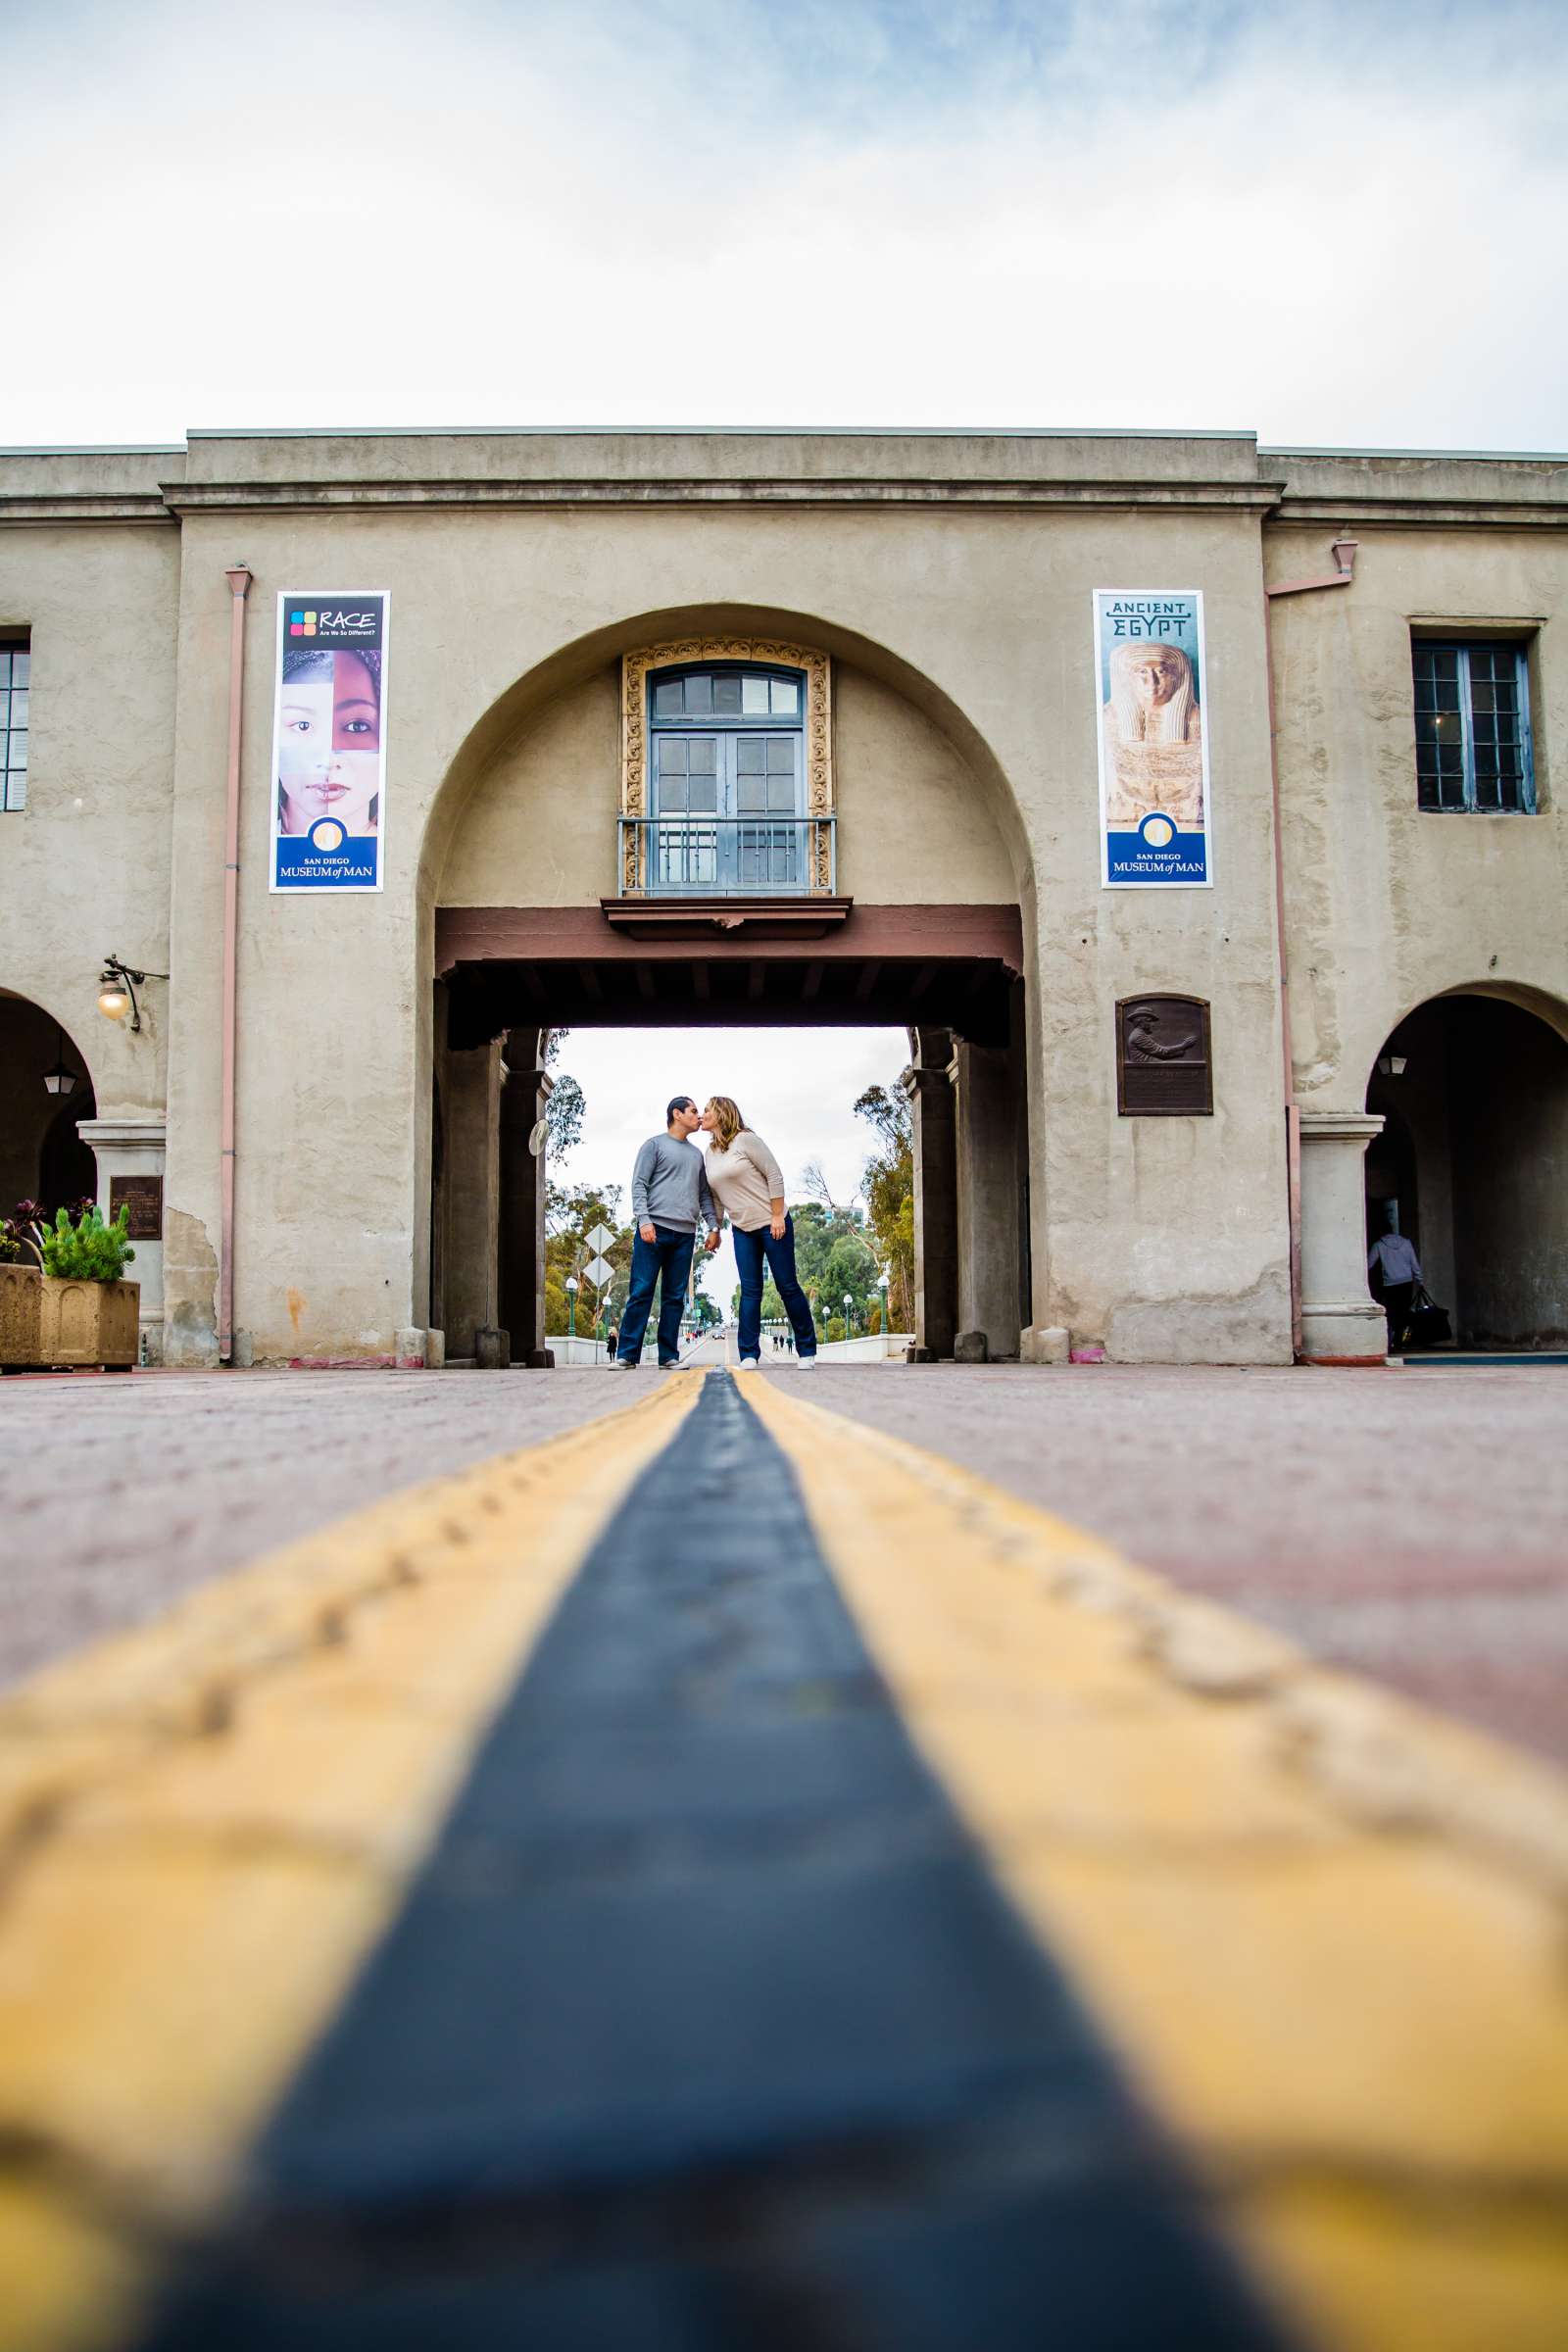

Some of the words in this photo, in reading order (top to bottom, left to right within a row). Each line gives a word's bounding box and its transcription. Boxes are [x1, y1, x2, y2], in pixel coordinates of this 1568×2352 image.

[1113, 603, 1186, 613] ANCIENT
[319, 612, 376, 628] RACE
[1113, 616, 1187, 636] EGYPT
[280, 866, 332, 877] MUSEUM
[332, 866, 343, 879] of
[343, 866, 373, 876] MAN
[1113, 862, 1164, 872] MUSEUM
[1164, 862, 1175, 875] of
[1175, 862, 1204, 872] MAN
